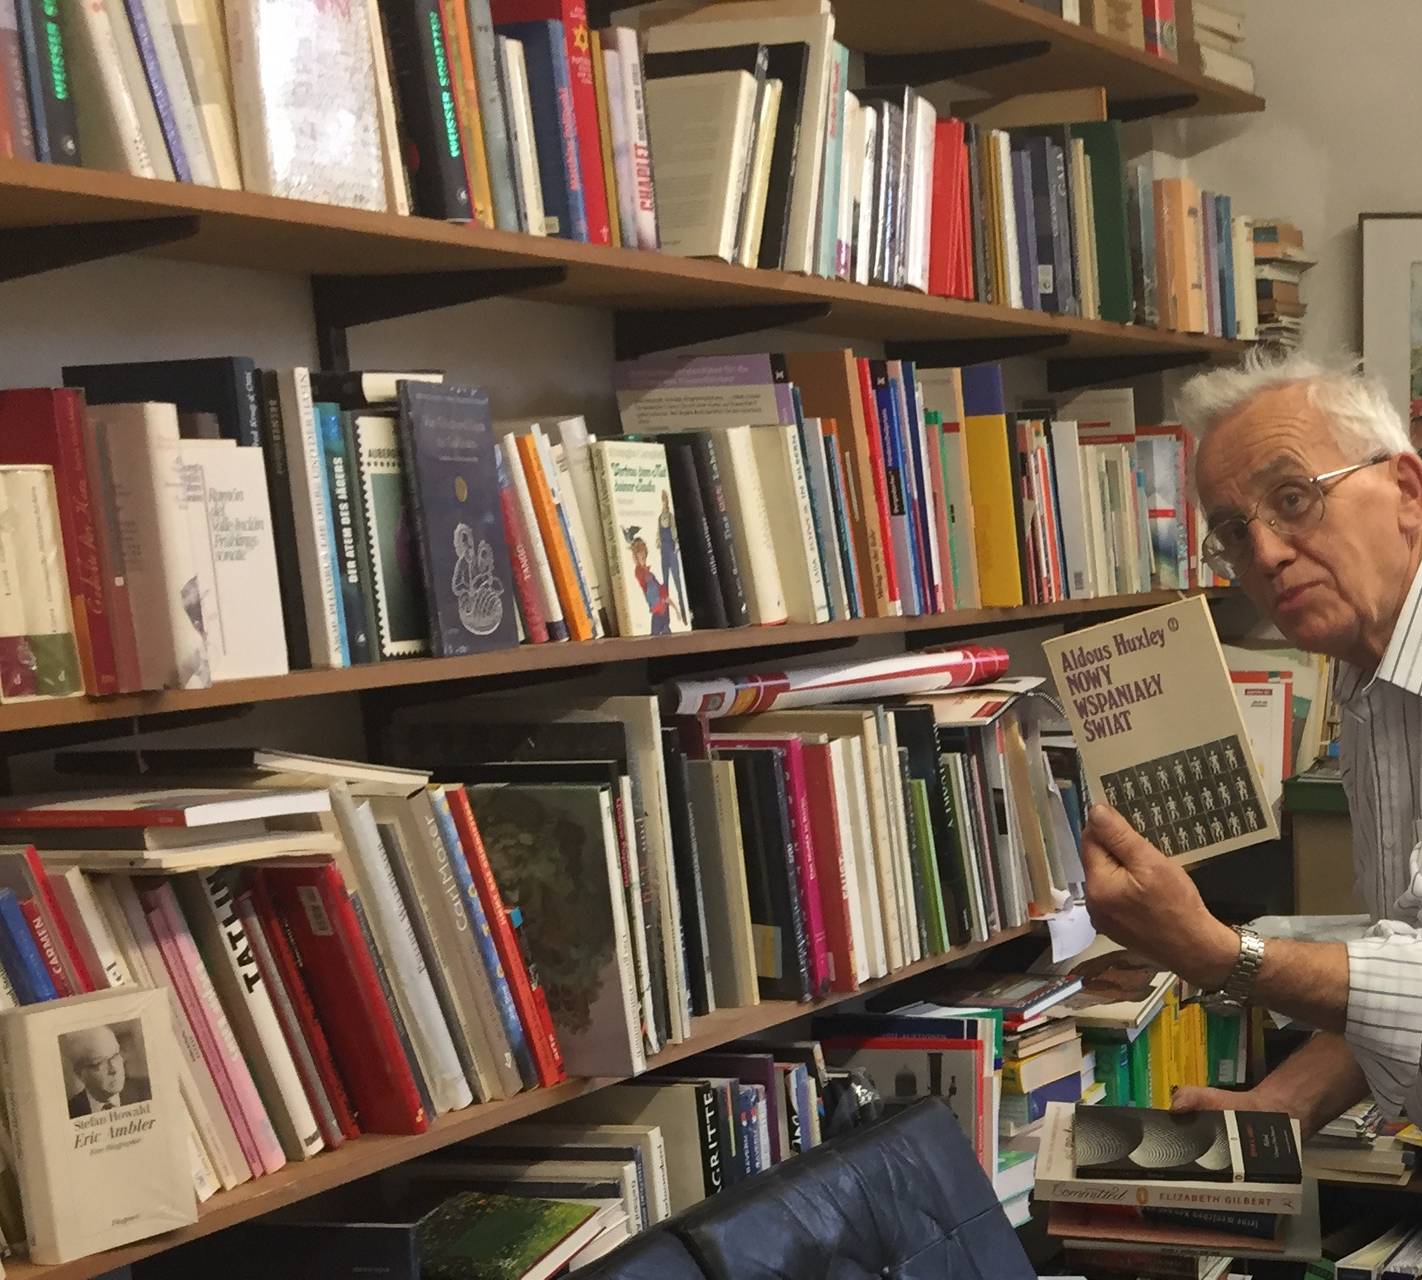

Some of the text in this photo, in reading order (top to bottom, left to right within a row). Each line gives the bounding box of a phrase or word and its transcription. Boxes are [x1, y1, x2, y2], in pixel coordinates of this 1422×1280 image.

[333, 456, 360, 585] DER ATEM DES JÄGERS
[1060, 627, 1165, 673] Aldous Huxley
[1066, 664, 1112, 697] NOWY
[1073, 674, 1164, 719] WSPANIAŁY
[1083, 710, 1133, 743] ŚWIAT
[33, 916, 63, 975] CARMEN
[206, 869, 261, 993] TATLIN
[74, 1118, 156, 1150] Eric Ambler
[704, 1091, 722, 1194] GRITTE
[1159, 1192, 1273, 1208] ELIZABETH GILBERT
